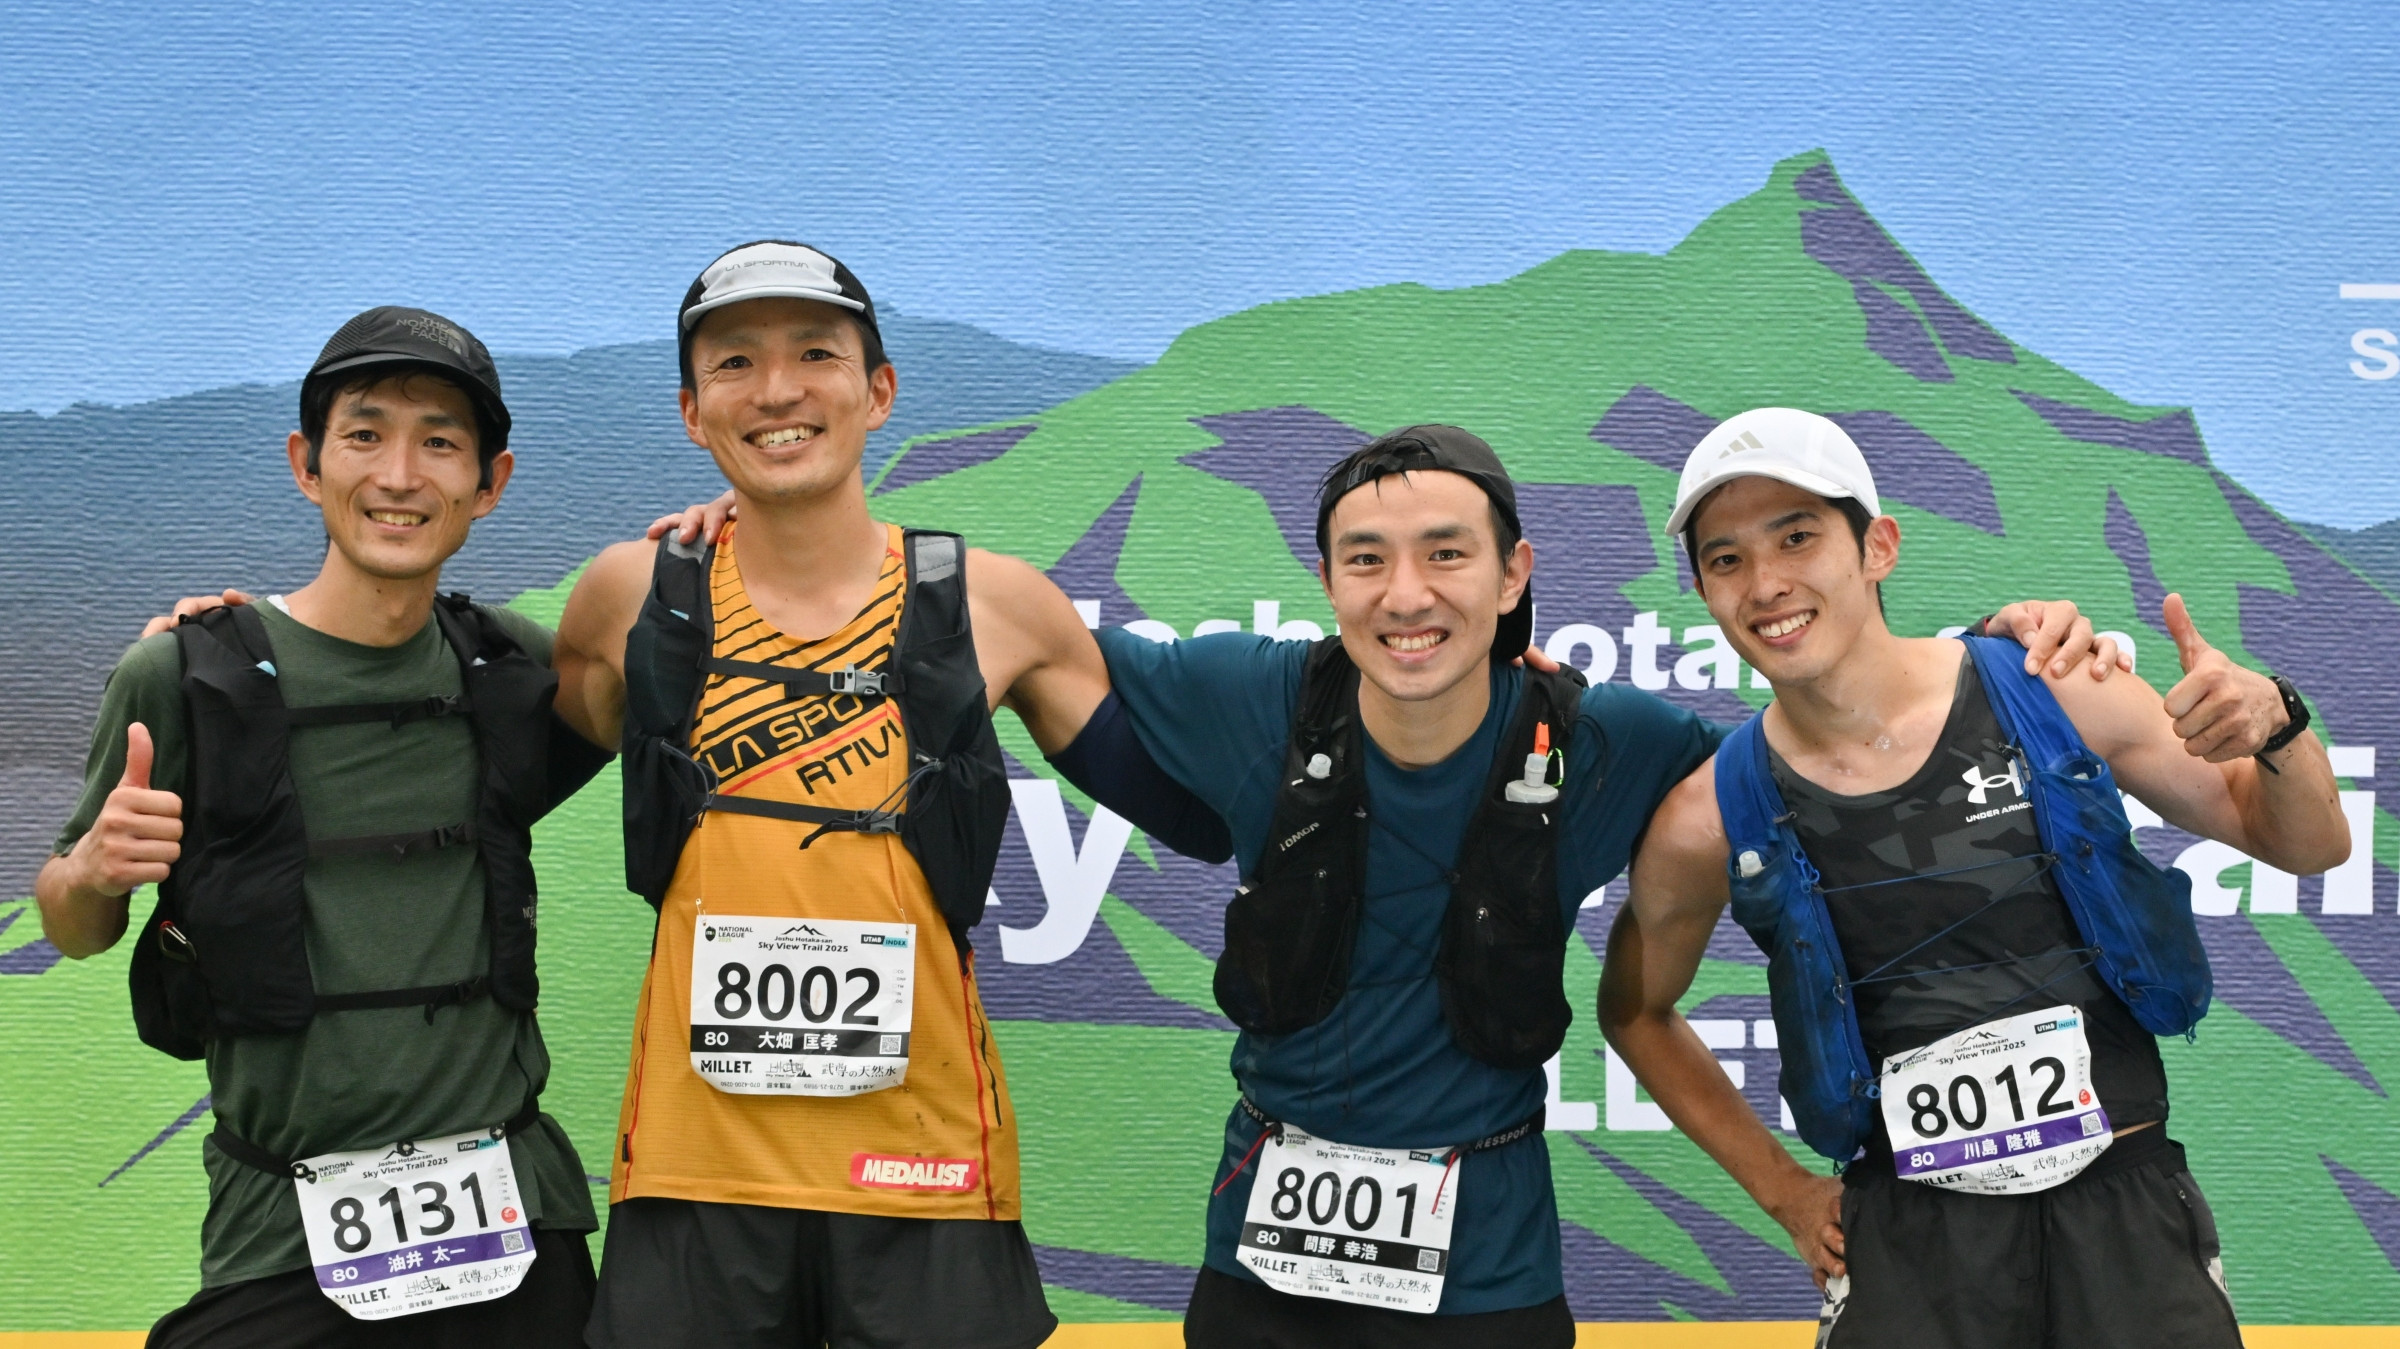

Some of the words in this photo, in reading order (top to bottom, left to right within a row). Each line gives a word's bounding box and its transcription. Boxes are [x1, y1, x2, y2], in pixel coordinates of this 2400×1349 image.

[743, 259, 809, 269] SPORTIVA
[396, 318, 449, 340] NORTH
[421, 316, 448, 329] THE
[410, 326, 447, 347] FACE
[706, 734, 765, 779] LA
[768, 692, 863, 750] SPO
[1965, 808, 2000, 823] UNDER
[2001, 801, 2033, 814] ARMOU
[758, 941, 774, 951] Sky
[776, 942, 800, 950] View
[802, 943, 823, 952] Trail
[825, 944, 848, 952] 2025
[714, 962, 880, 1026] 8002
[2036, 1022, 2055, 1032] UTMB
[704, 1031, 729, 1046] 80
[758, 1031, 794, 1050] 大畑
[802, 1033, 839, 1051] 匡孝
[1953, 1046, 1971, 1054] Joshu
[1939, 1056, 1954, 1065] Sky
[1956, 1052, 1978, 1061] View
[1980, 1045, 2001, 1056] Trail
[2003, 1040, 2026, 1051] 2025
[701, 1060, 751, 1073] MILLET
[1906, 1056, 2074, 1139] 8012
[1316, 1149, 1329, 1159] Sky
[1330, 1151, 1350, 1160] View
[1352, 1153, 1372, 1162] Trail
[1374, 1156, 1397, 1166] 2025
[1910, 1151, 1935, 1167] 80
[1964, 1138, 1998, 1160] 川島
[2005, 1128, 2043, 1152] 隆雅
[318, 1160, 355, 1173] NATIONAL
[319, 1167, 347, 1178] LEAGUE
[363, 1169, 379, 1178] Sky
[380, 1166, 404, 1175] View
[405, 1161, 425, 1171] Trail
[427, 1156, 448, 1167] 2025
[377, 1160, 396, 1168] Joshu
[861, 1158, 970, 1187] MEDALIST
[330, 1171, 488, 1254] 8131
[1271, 1167, 1418, 1238] 8001
[1256, 1230, 1280, 1246] 80
[1303, 1234, 1336, 1255] 間野
[1344, 1240, 1378, 1261] 幸浩
[332, 1266, 358, 1283] 80
[388, 1251, 423, 1273] 油井
[432, 1245, 466, 1264] 太一
